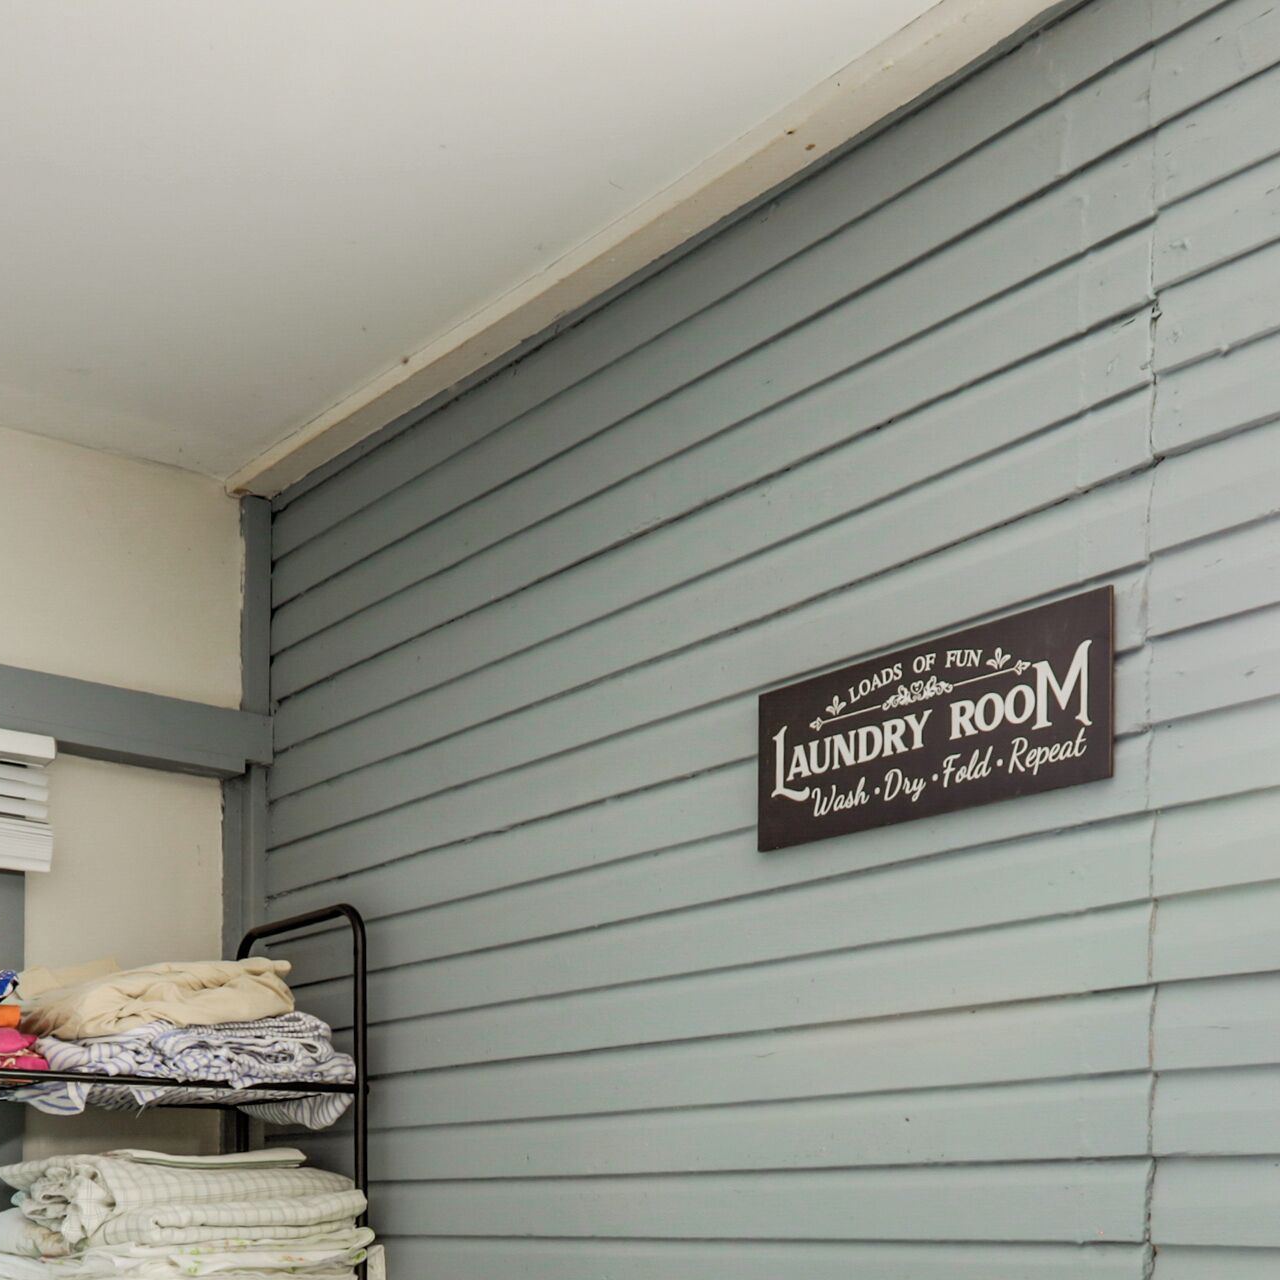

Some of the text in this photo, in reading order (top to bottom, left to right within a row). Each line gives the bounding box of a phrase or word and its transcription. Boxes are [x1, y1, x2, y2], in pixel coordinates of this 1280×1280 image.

[771, 639, 1092, 801] LAUNDRY ROOM
[848, 649, 982, 703] LOADS OF FUN
[811, 727, 1086, 817] Wash Dry Fold Repeat
